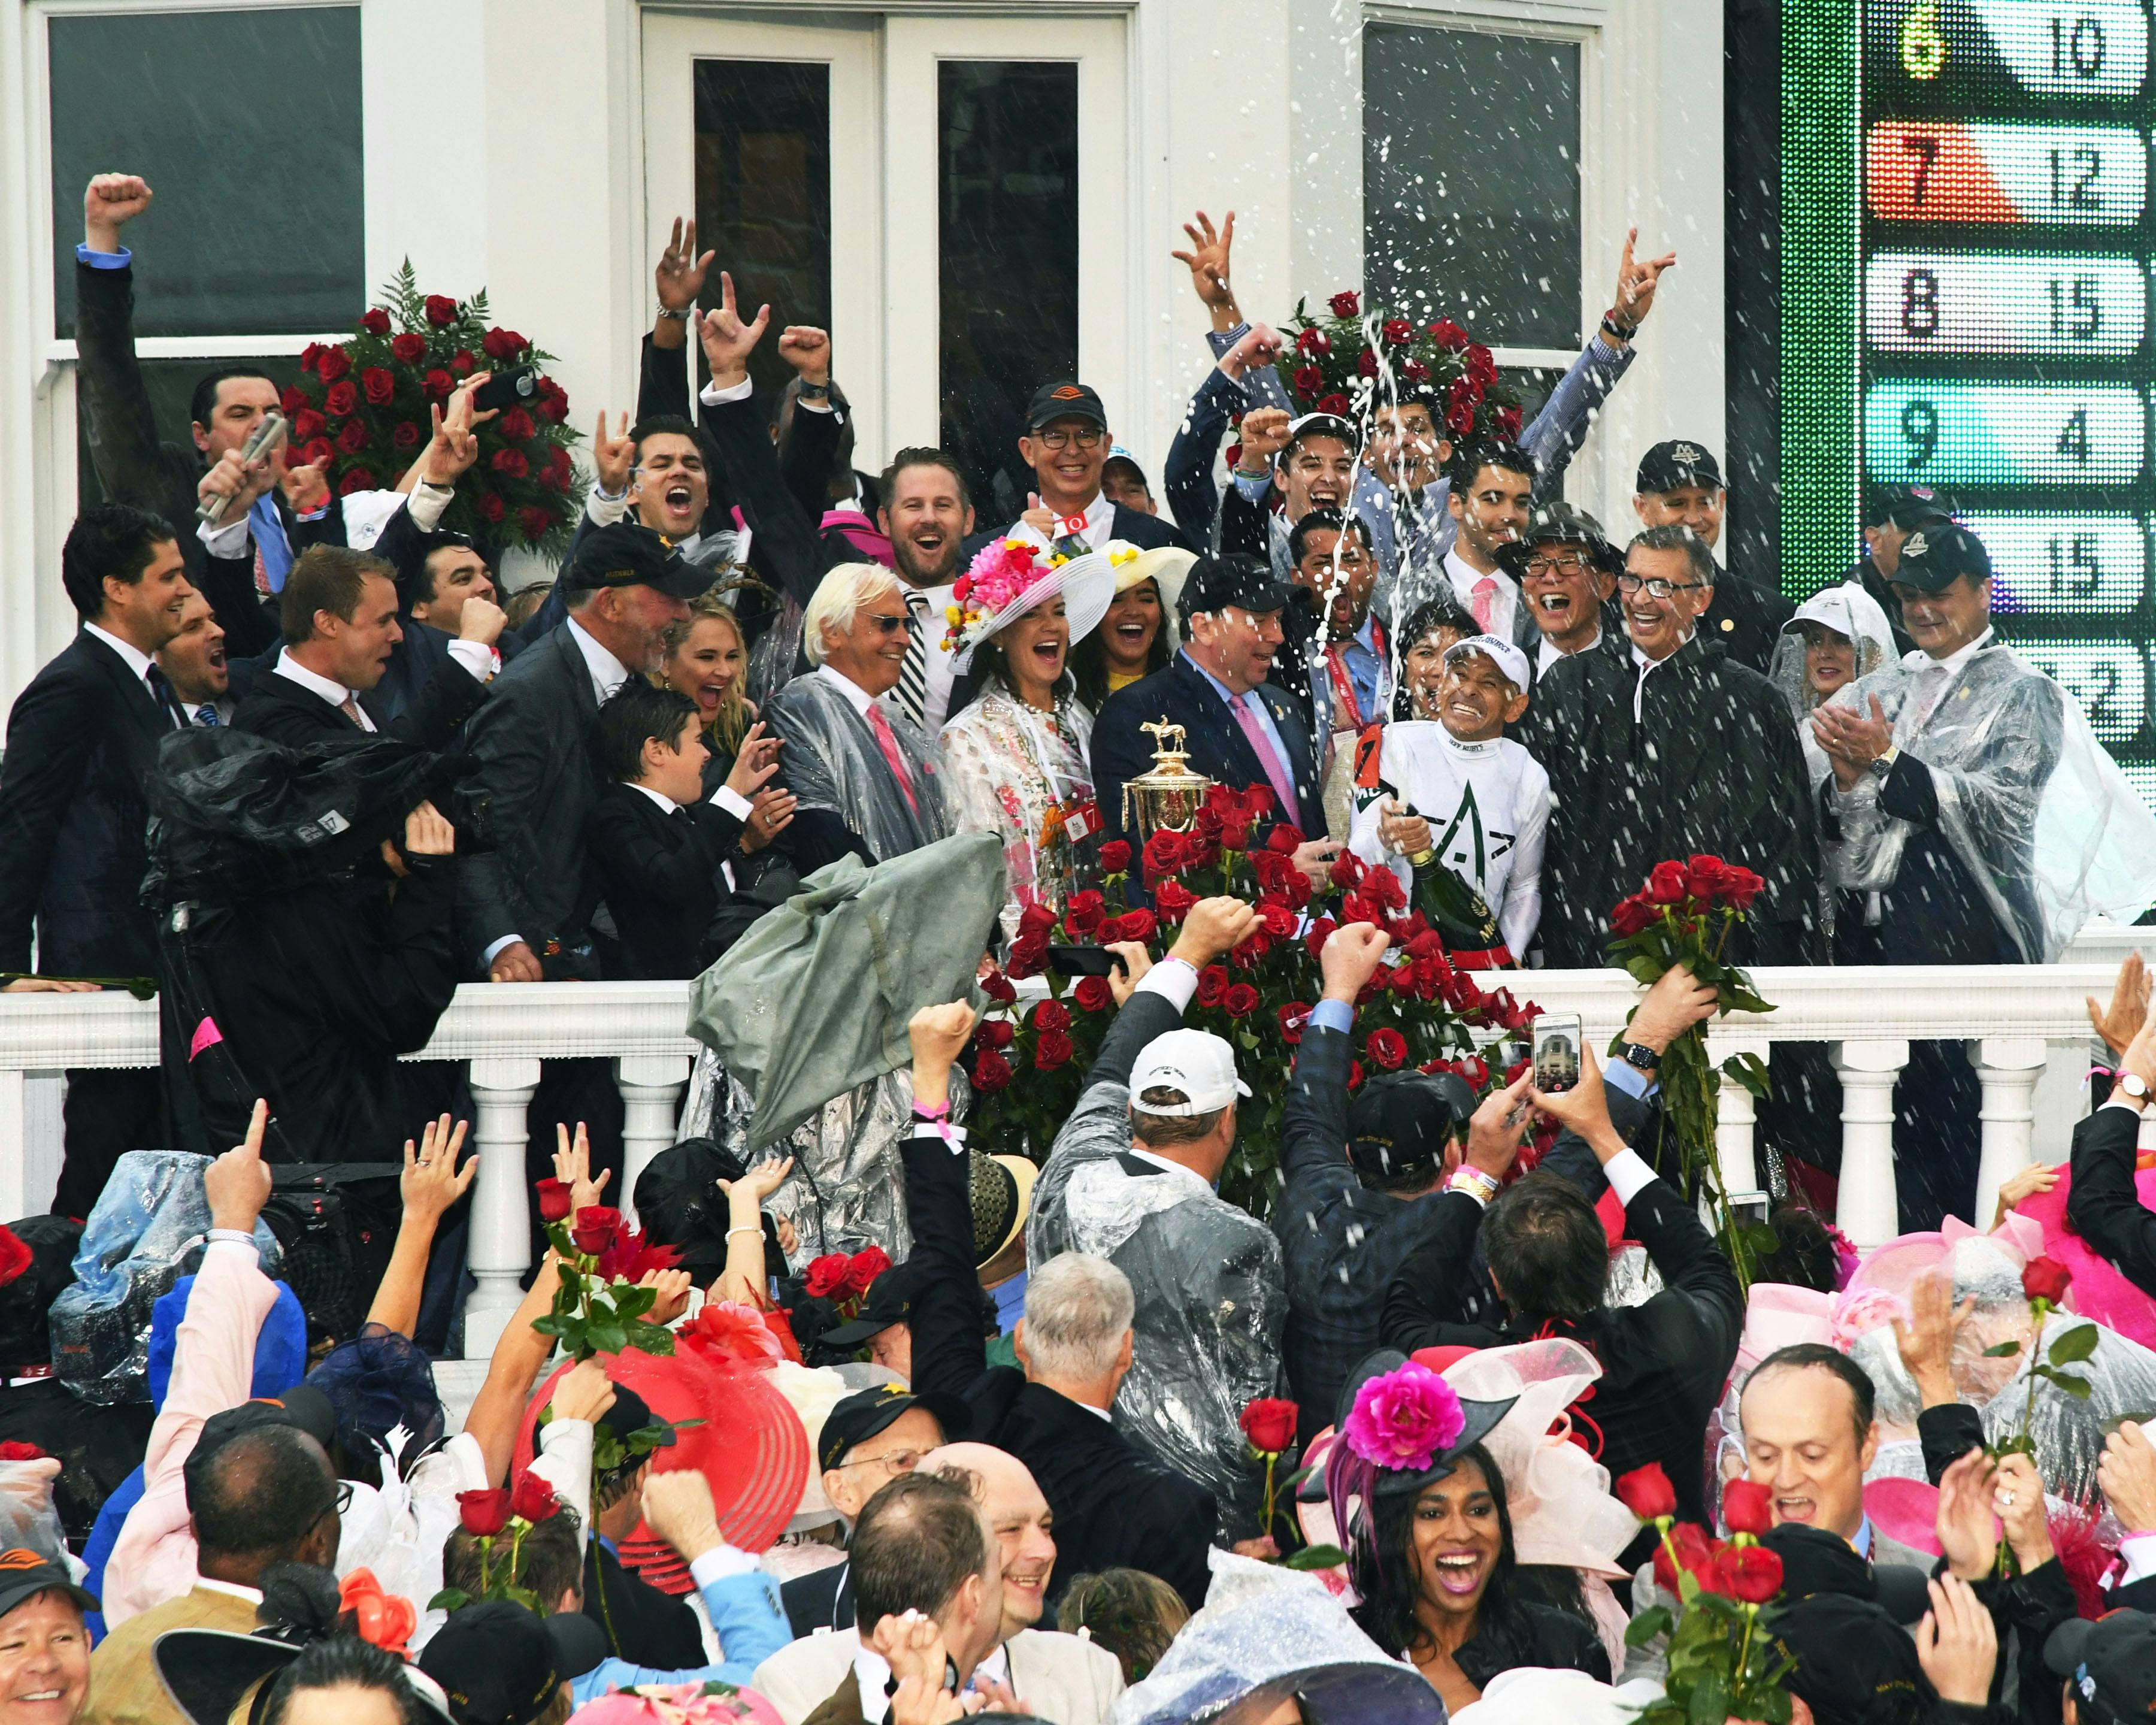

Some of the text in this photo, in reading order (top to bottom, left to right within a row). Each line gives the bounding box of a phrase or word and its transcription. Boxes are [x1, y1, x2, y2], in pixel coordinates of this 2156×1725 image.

[1901, 5, 2106, 80] 6 10
[1902, 137, 2100, 208] 7 12
[1901, 267, 2100, 338] 8 15
[1901, 400, 2089, 468] 9 4
[2049, 532, 2099, 597] 15
